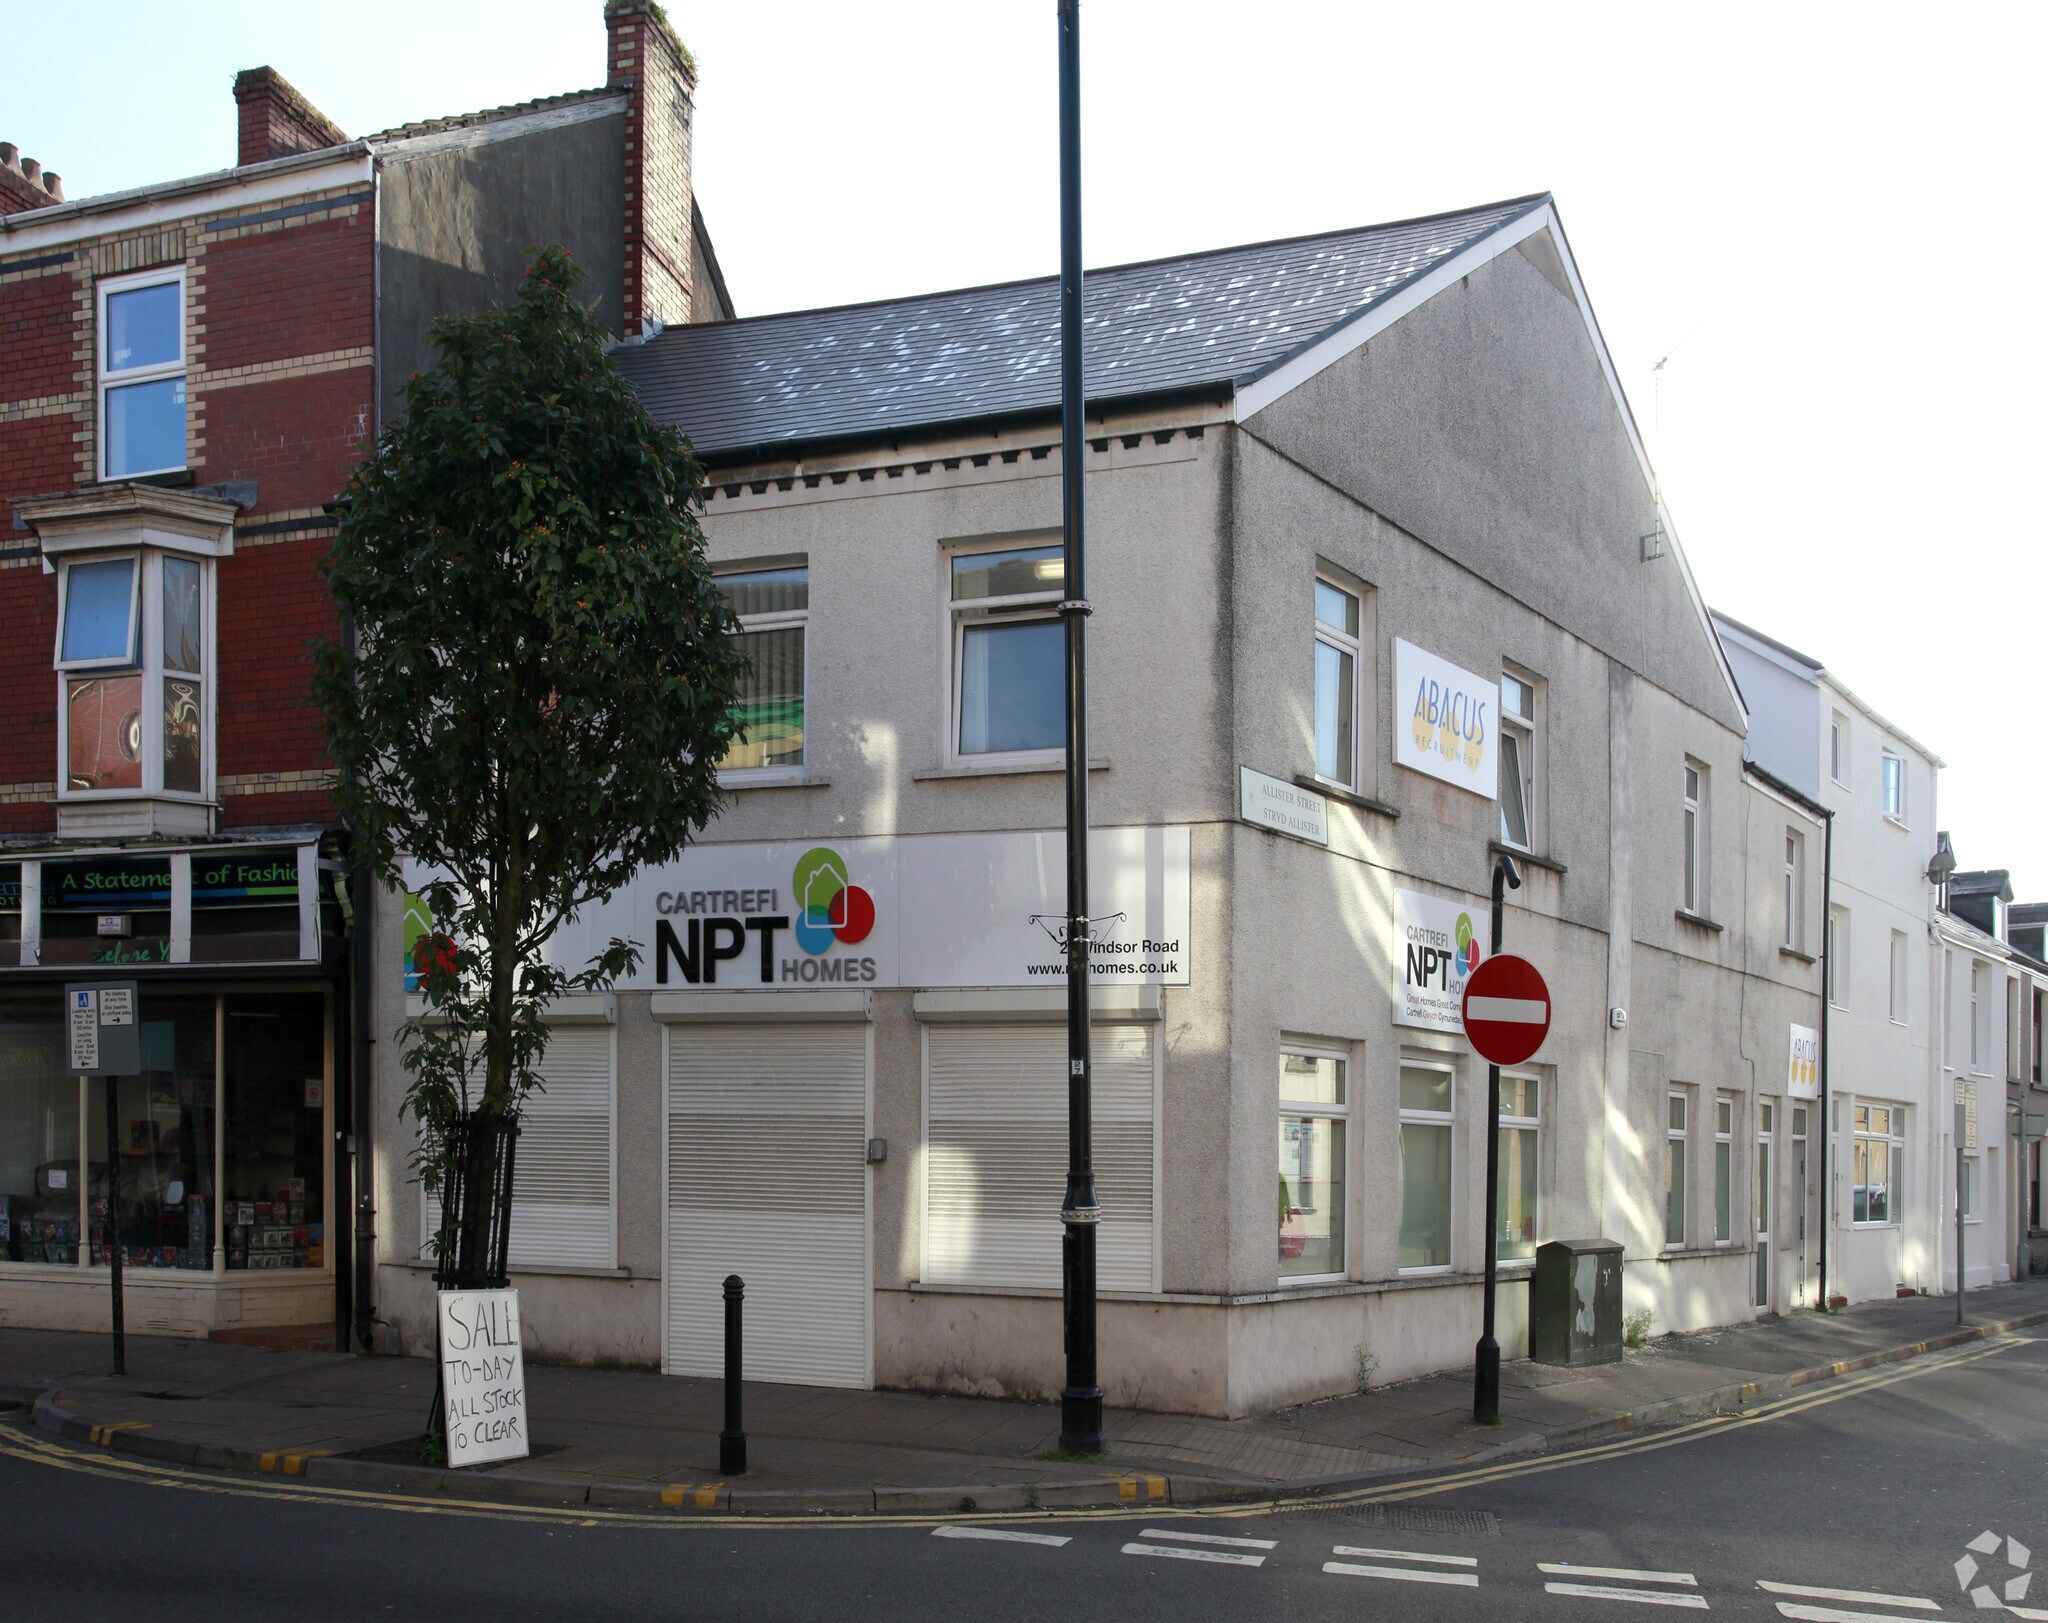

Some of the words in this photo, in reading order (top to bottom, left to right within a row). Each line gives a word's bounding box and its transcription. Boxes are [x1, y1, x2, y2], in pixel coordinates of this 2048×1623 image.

[1414, 676, 1486, 746] ABACUS
[1415, 733, 1479, 766] RECRUITMENT
[1261, 784, 1295, 805] ALLISTER
[1296, 795, 1321, 813] STREET
[1263, 807, 1287, 825] STRYD
[1288, 816, 1320, 836] ALLISTER
[62, 873, 78, 888] A
[84, 868, 198, 889] Statemet
[205, 864, 231, 884] of
[656, 888, 777, 914] CARTREFI
[656, 916, 789, 983] NPT
[1142, 940, 1179, 953] Road
[1406, 924, 1449, 948] CARTREFI
[781, 957, 877, 982] HOMES
[1406, 942, 1452, 991] NPT
[1407, 993, 1419, 1004] Great
[1420, 996, 1436, 1007] Homes
[1793, 1038, 1817, 1063] ABACUS
[448, 1297, 519, 1351] SALE
[445, 1354, 516, 1386] TO-DAY
[448, 1396, 480, 1421] ALL
[483, 1388, 523, 1414] STOCK
[474, 1416, 522, 1444] CLEAR
